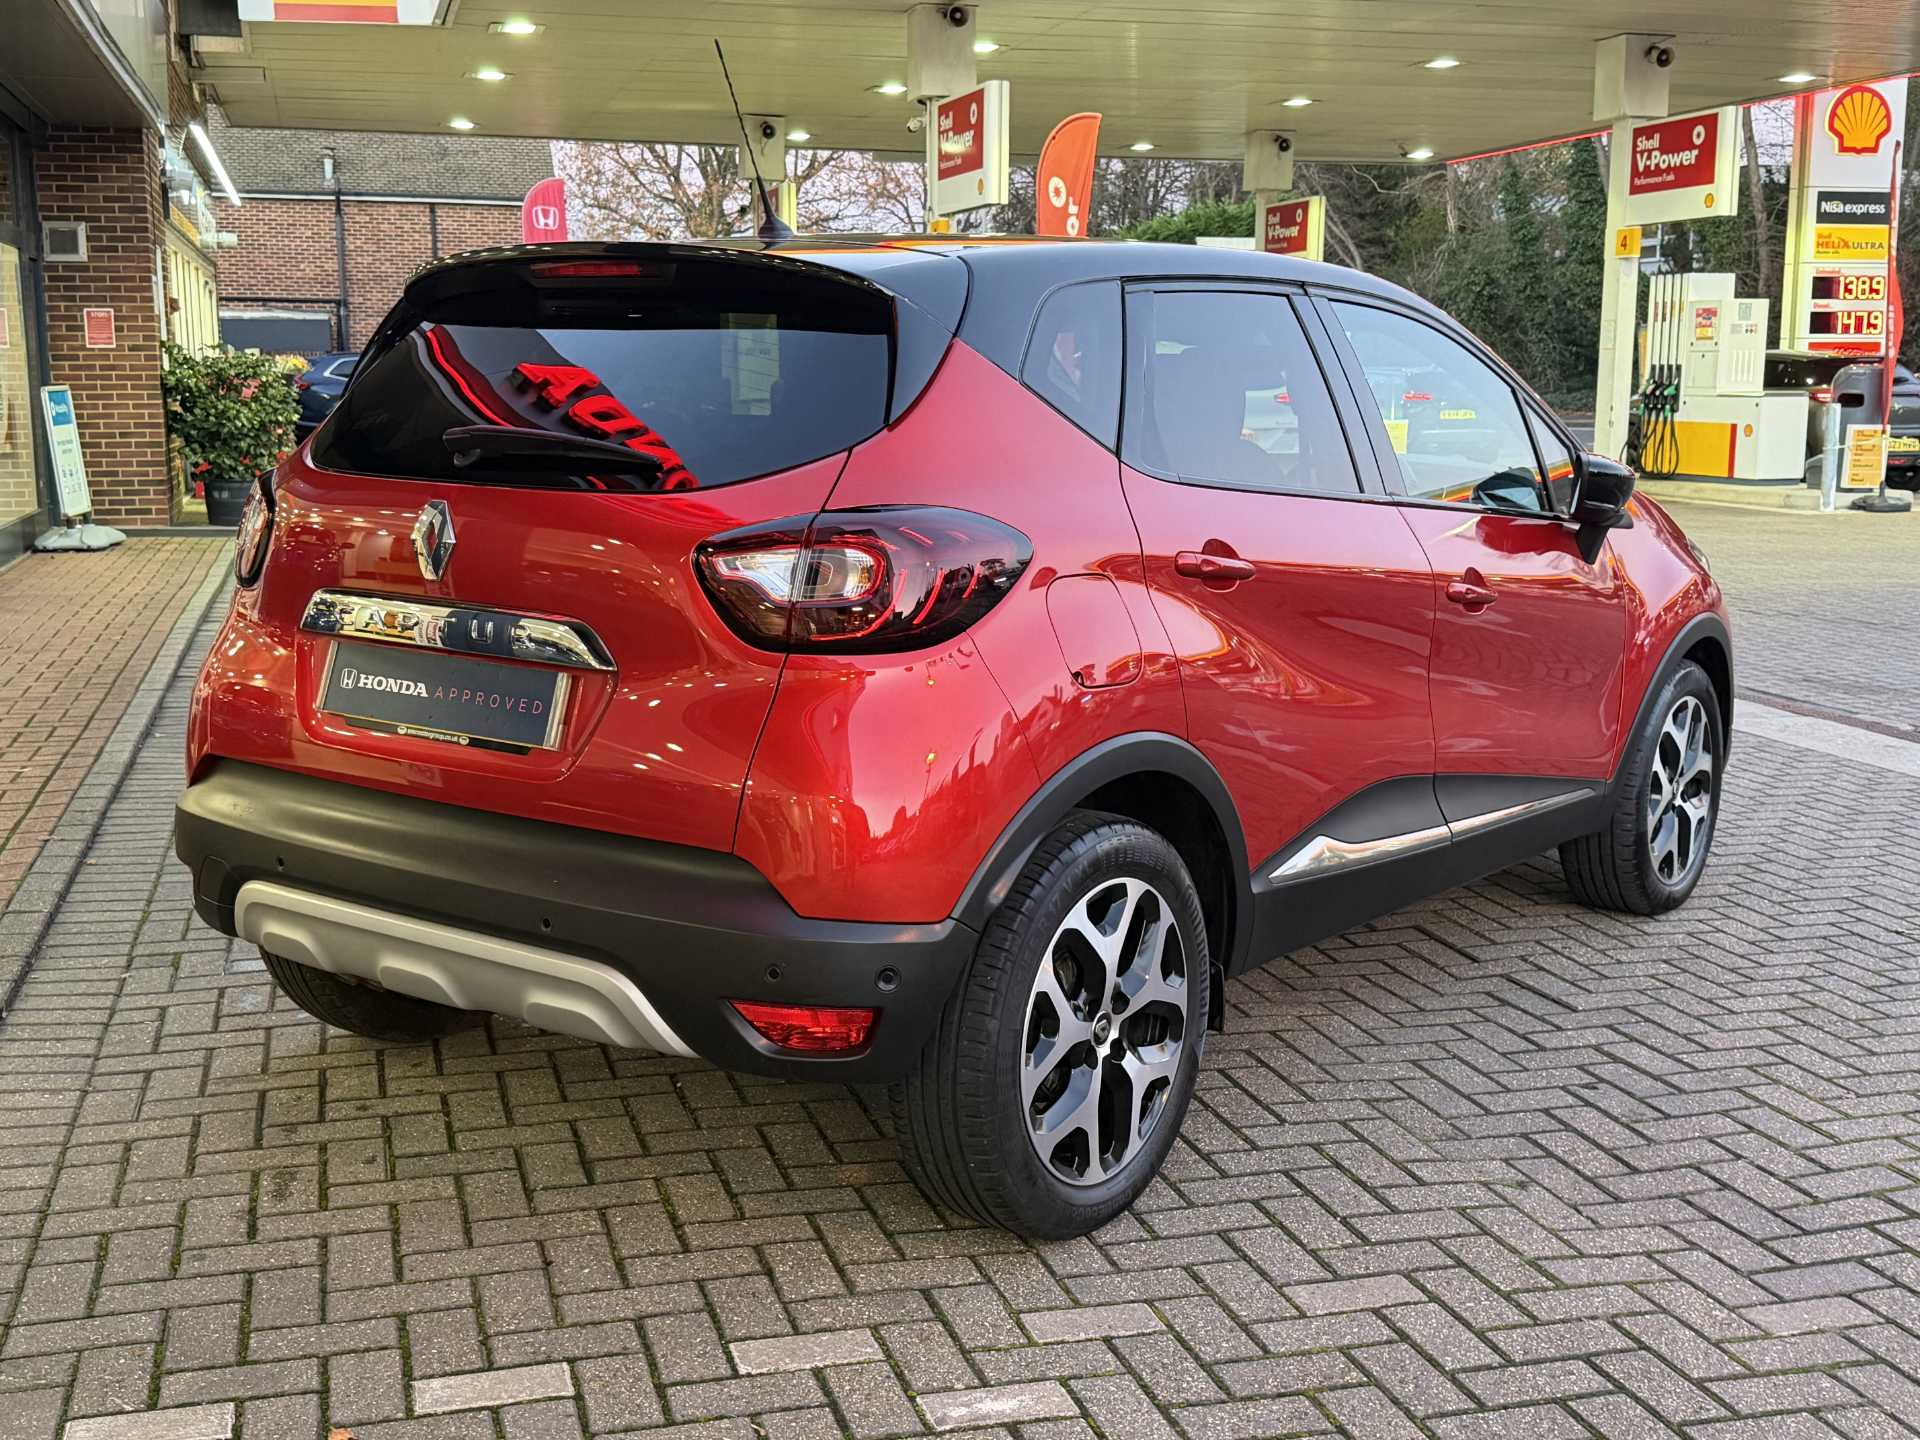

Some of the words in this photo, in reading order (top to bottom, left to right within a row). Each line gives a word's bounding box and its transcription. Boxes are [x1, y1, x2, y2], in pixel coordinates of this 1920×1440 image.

[939, 111, 953, 131] Shell
[940, 130, 975, 155] V-Power
[1636, 133, 1660, 151] Shell
[1636, 149, 1699, 173] V-Power
[1820, 201, 1843, 213] Nisa
[1844, 202, 1886, 216] express
[1267, 225, 1300, 240] V-Power
[1620, 234, 1628, 251] 4
[1816, 237, 1850, 249] HELIX
[1852, 241, 1885, 250] ULTRA
[1839, 276, 1885, 300] 138.9
[1836, 311, 1883, 335] 147.9
[358, 673, 429, 698] HONDA
[434, 686, 543, 715] APPROVED
